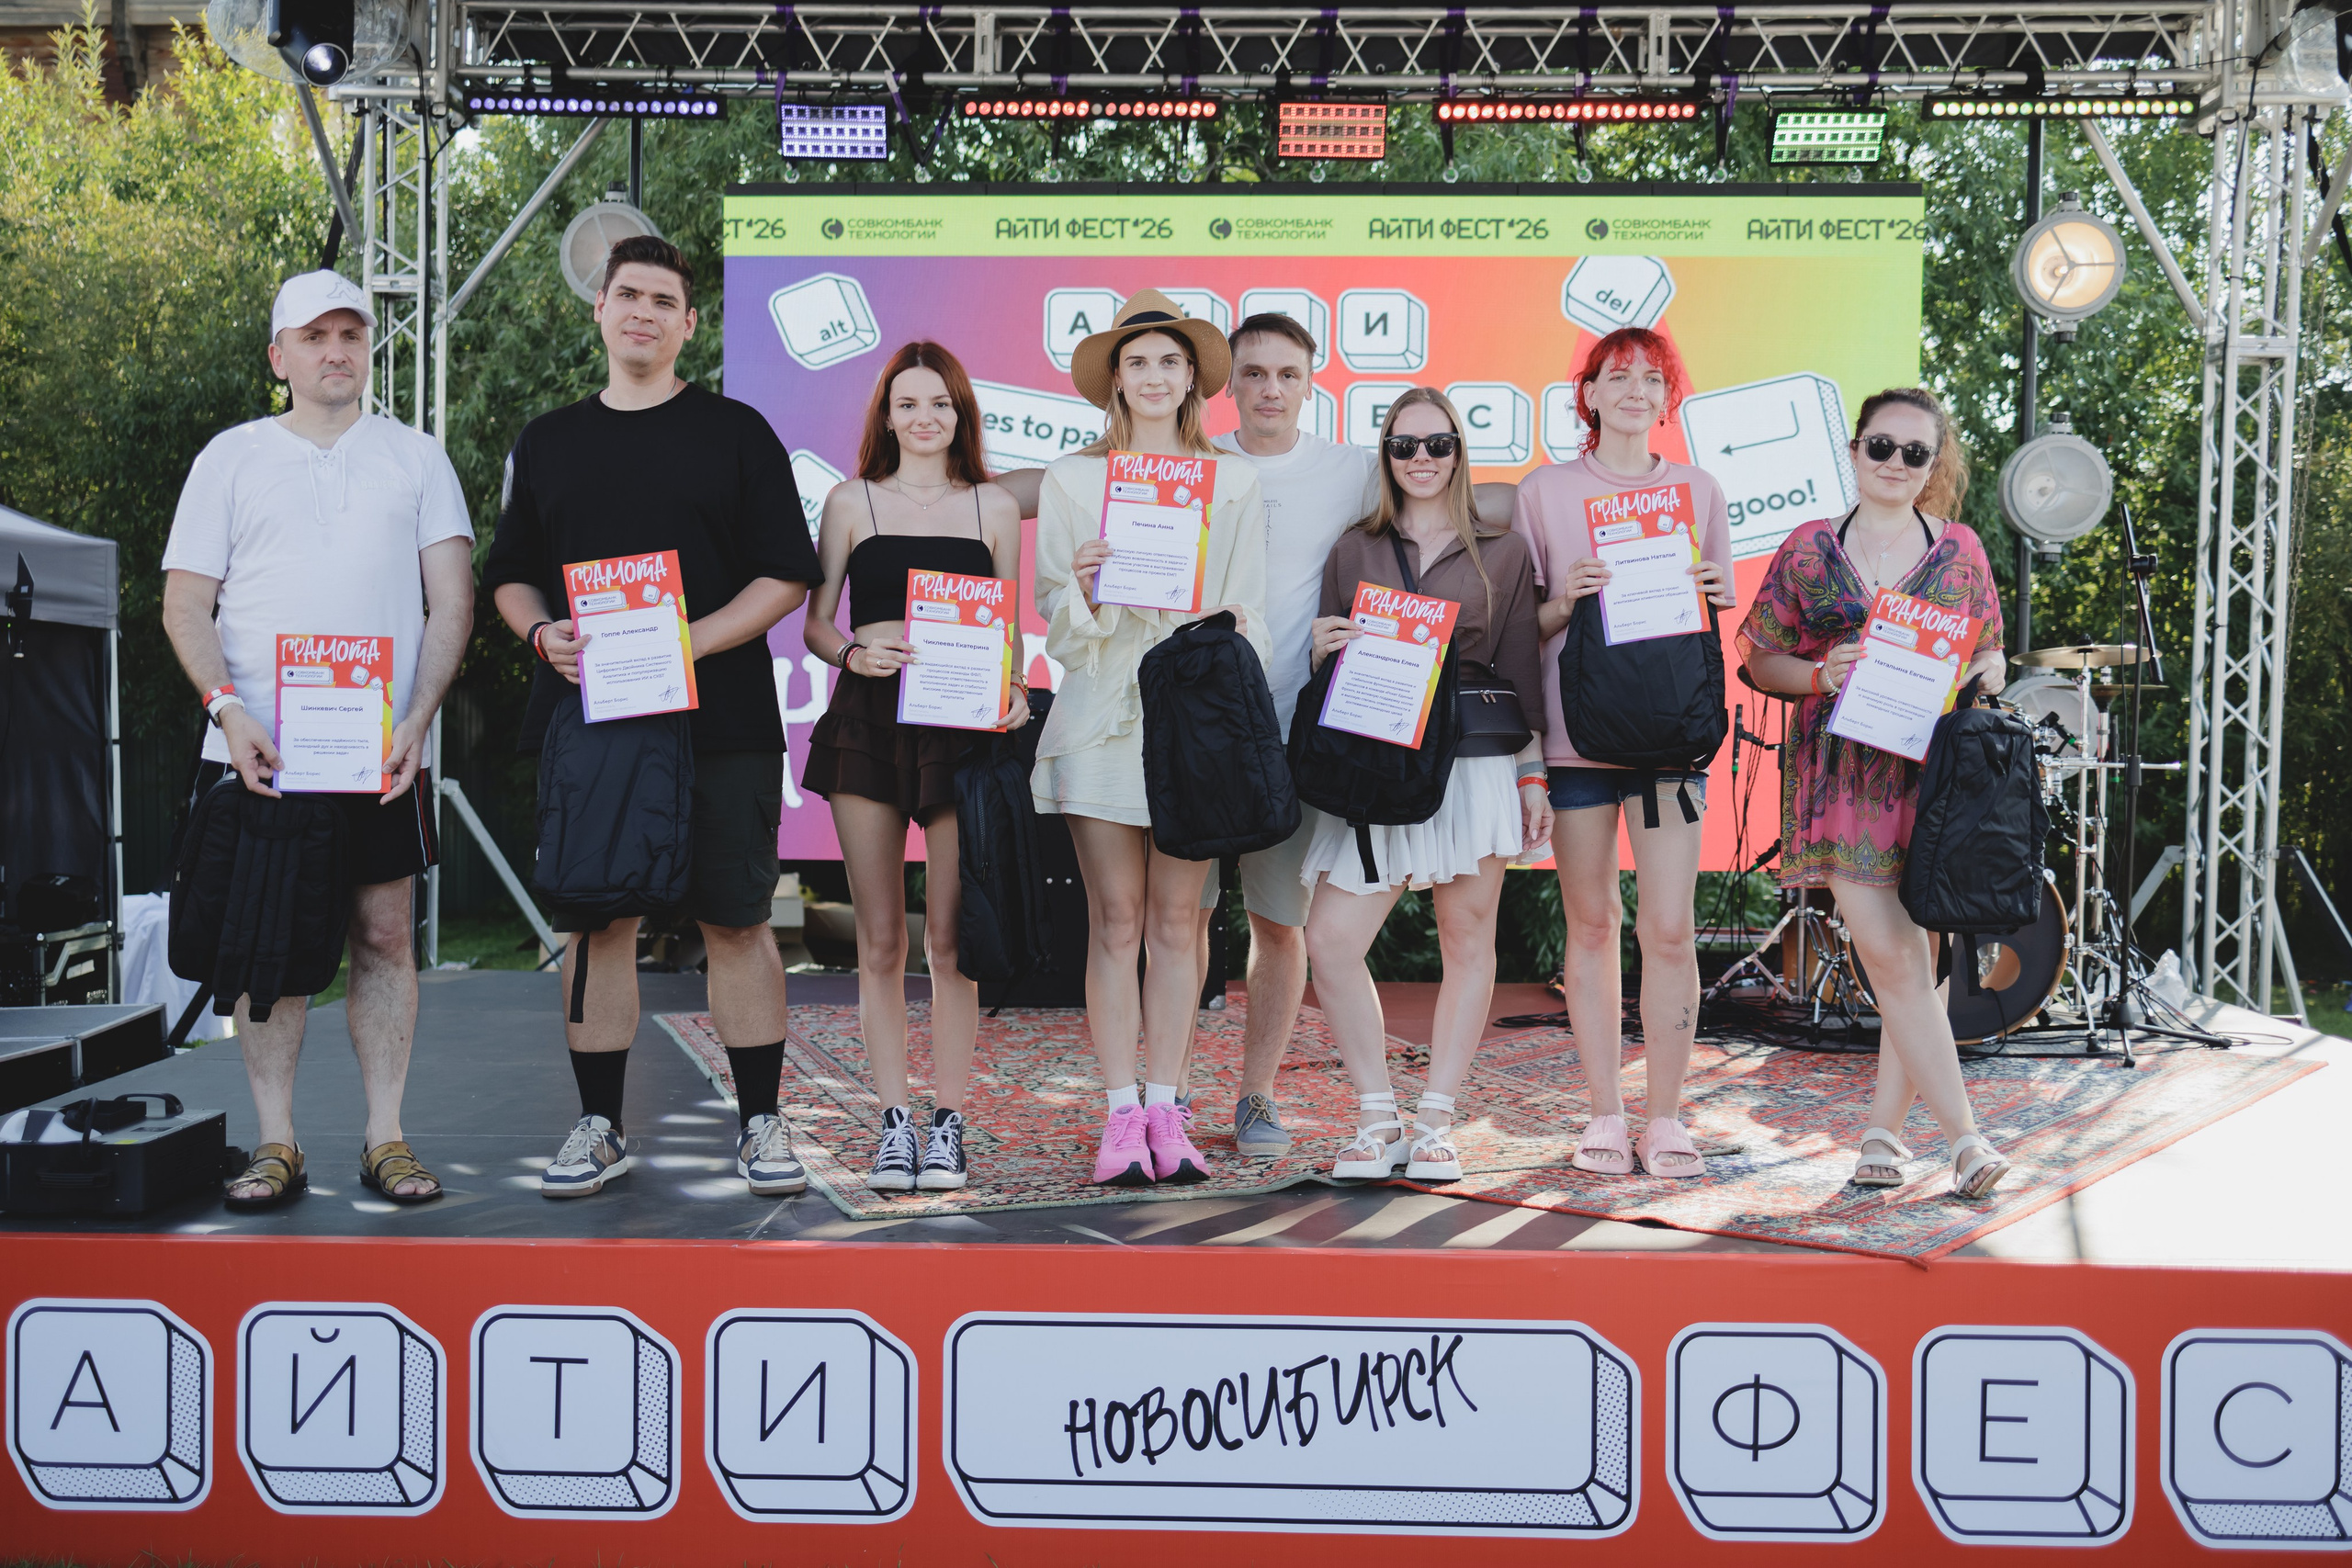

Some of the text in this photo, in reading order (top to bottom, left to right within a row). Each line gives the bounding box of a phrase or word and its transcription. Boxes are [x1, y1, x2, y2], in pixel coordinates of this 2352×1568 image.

[847, 219, 943, 229] СОВКОМБАНК
[848, 230, 936, 240] ТЕХНОЛОГИИ
[1236, 219, 1333, 229] СОВКОМБАНК
[1236, 230, 1327, 240] ТЕХНОЛОГИИ
[1612, 219, 1711, 229] СОВКОМБАНК
[1612, 230, 1704, 240] ТЕХНОЛОГИИ
[1595, 289, 1632, 314] del
[820, 321, 848, 341] alt
[984, 412, 1099, 450] es to pa
[1113, 454, 1204, 486] ГРАМОТА
[1589, 487, 1680, 524] ГРАМОТА
[1727, 479, 1816, 525] gooo!
[570, 554, 667, 592] ГРАМОТА
[1614, 556, 1649, 566] Литвинова
[913, 573, 1004, 605] ГРАМОТА
[1359, 588, 1446, 625] ГРАМОТА
[1877, 593, 1970, 640] ГРАМОТА
[621, 626, 658, 635] Александр
[281, 637, 380, 665] ГРАМОТА
[922, 638, 989, 650] Чиклеева Екатерина
[1357, 649, 1419, 667] Александрова Елена
[1874, 658, 1935, 682] Натальина Евгения
[1065, 1334, 1477, 1476] НОВОСИБИРСК
